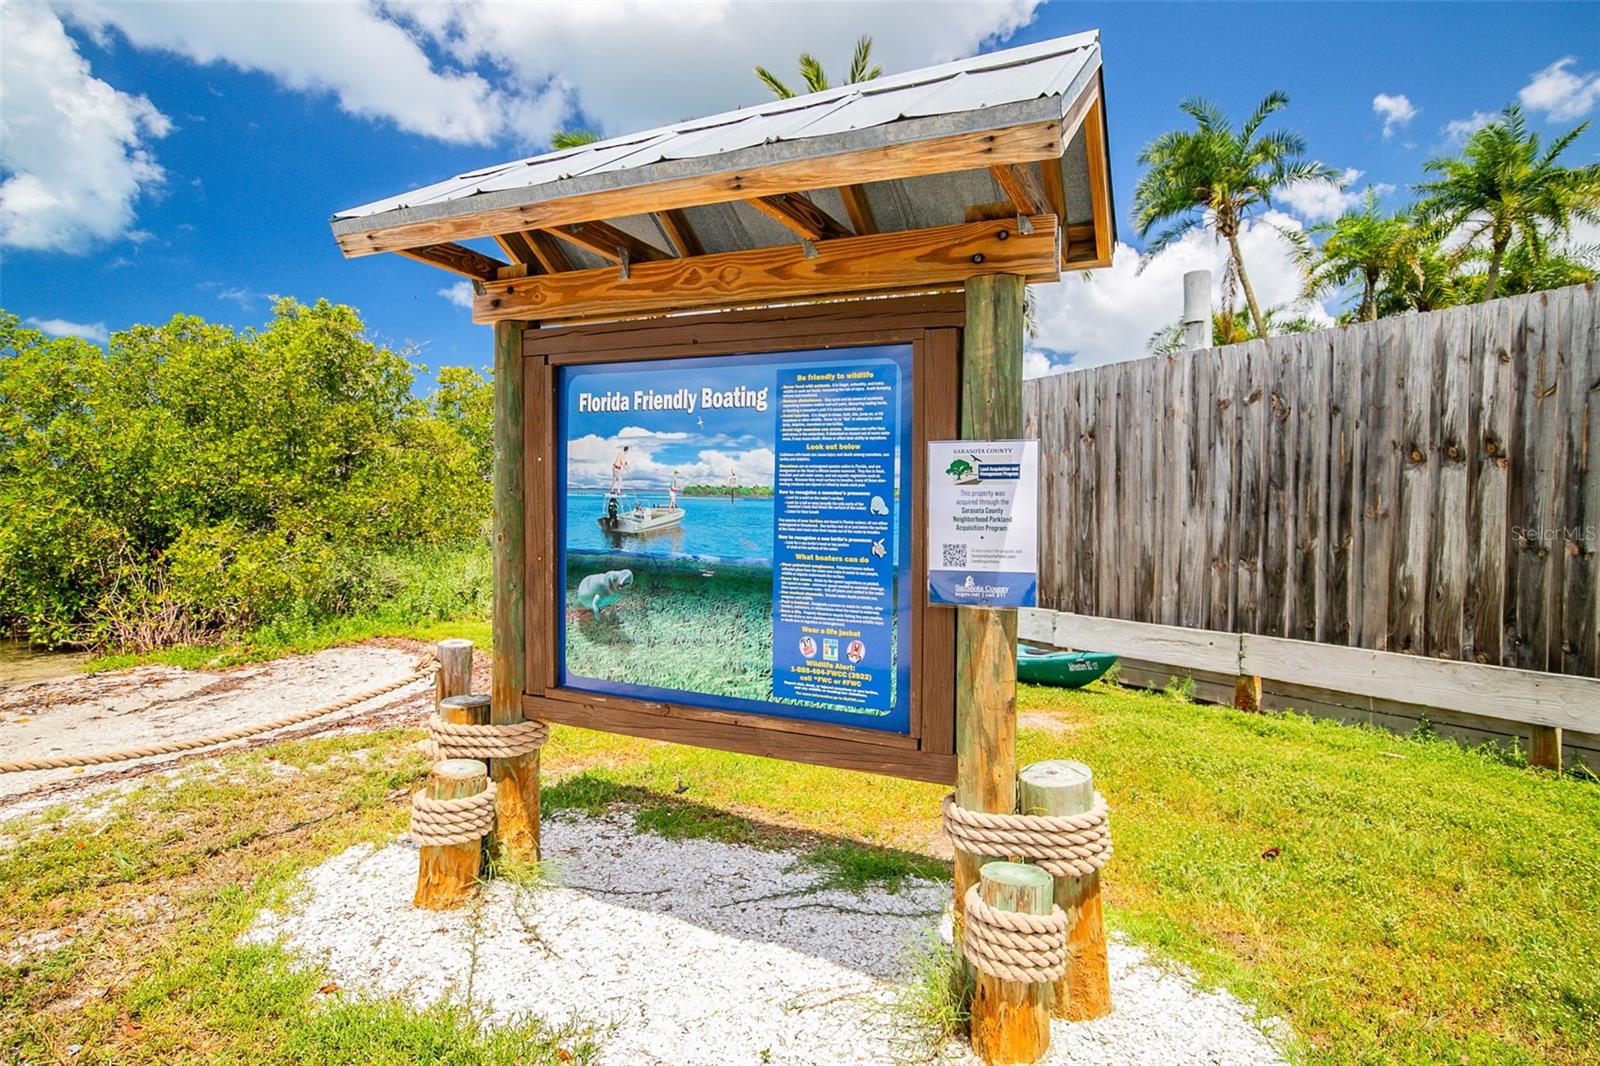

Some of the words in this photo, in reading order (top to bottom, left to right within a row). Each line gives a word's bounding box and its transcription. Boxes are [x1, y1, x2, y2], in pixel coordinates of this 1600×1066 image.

[579, 392, 629, 412] Florida
[634, 388, 697, 413] Friendly
[701, 386, 768, 412] Boating
[985, 585, 1009, 594] County
[839, 629, 860, 637] jacket
[806, 660, 833, 668] Wildlife
[835, 663, 855, 671] Alert:
